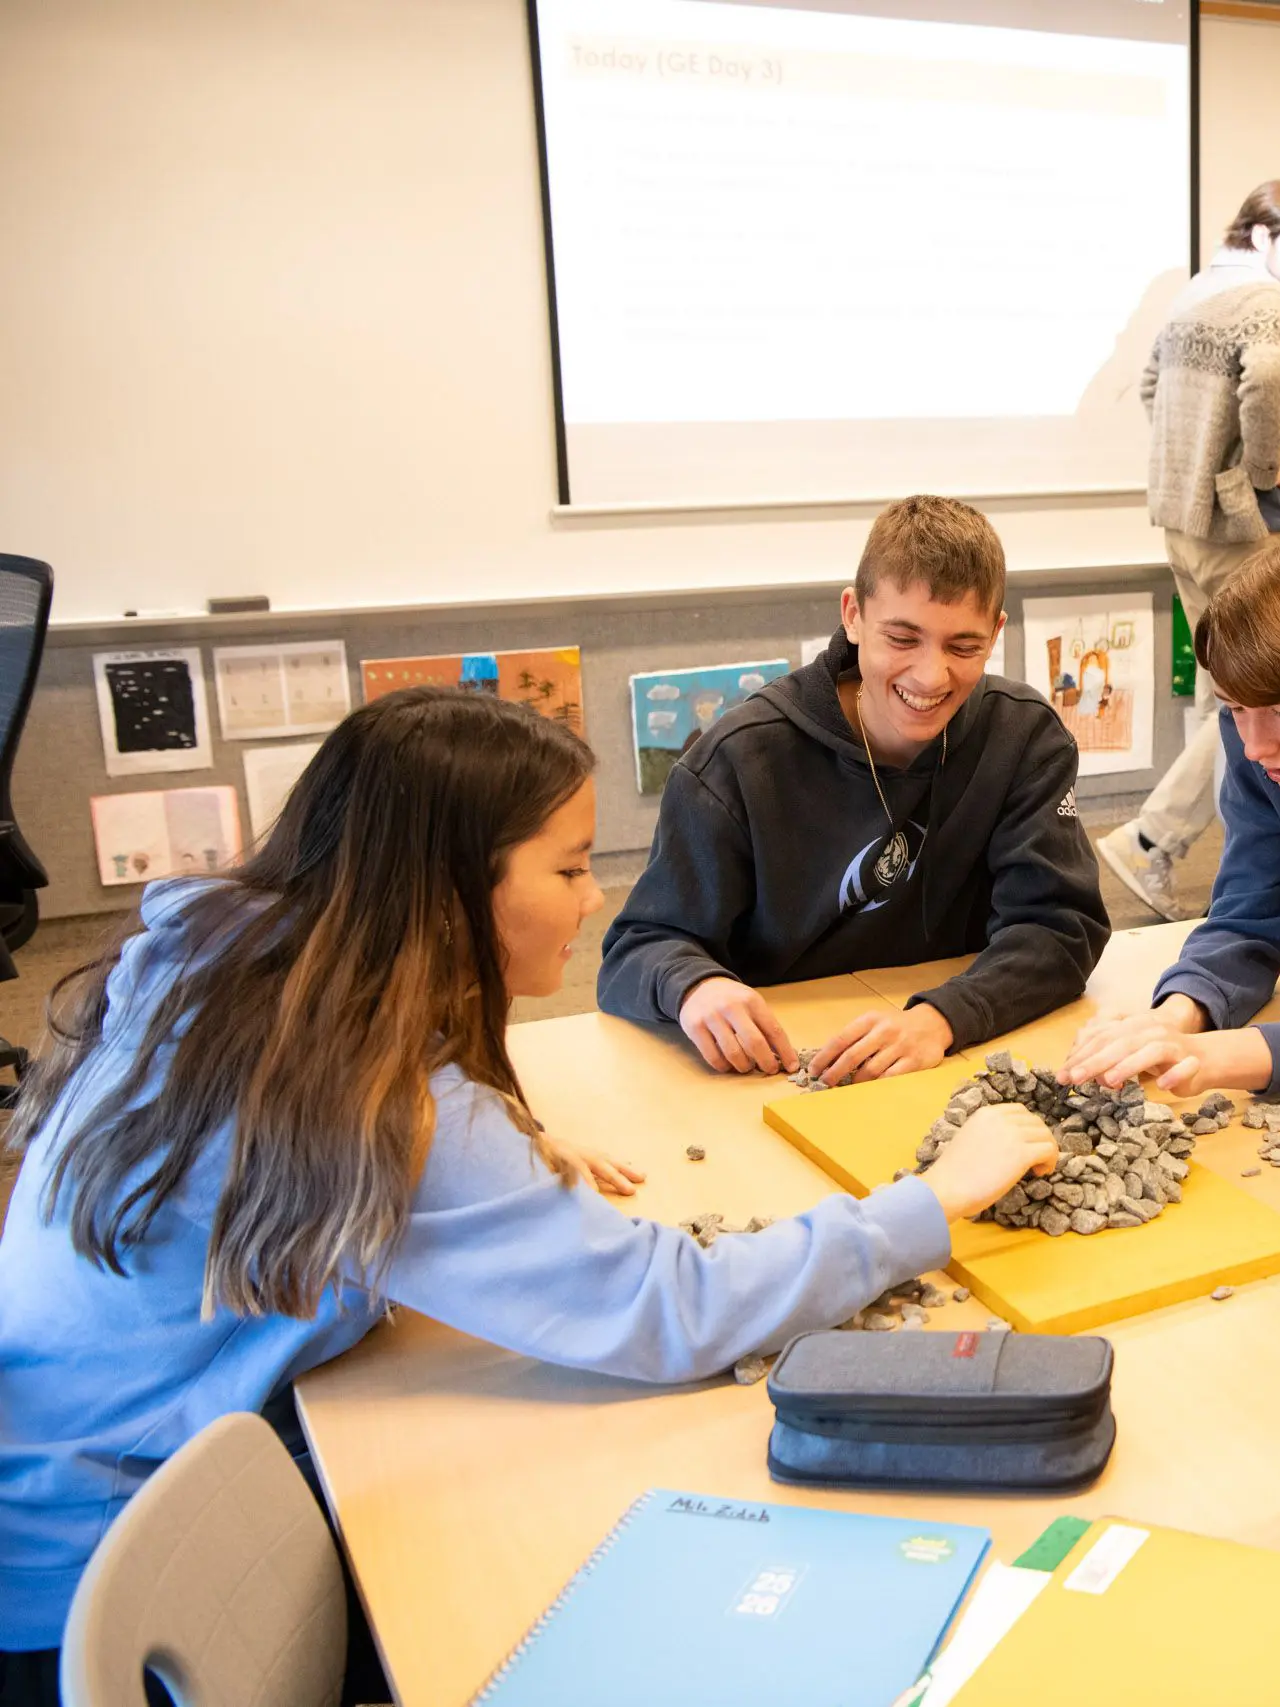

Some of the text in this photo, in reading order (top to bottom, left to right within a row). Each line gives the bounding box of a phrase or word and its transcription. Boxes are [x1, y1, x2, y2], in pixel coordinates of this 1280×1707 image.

[572, 44, 784, 85] Today (GE Day 3)
[752, 1571, 795, 1595] 25
[736, 1593, 780, 1615] 26
